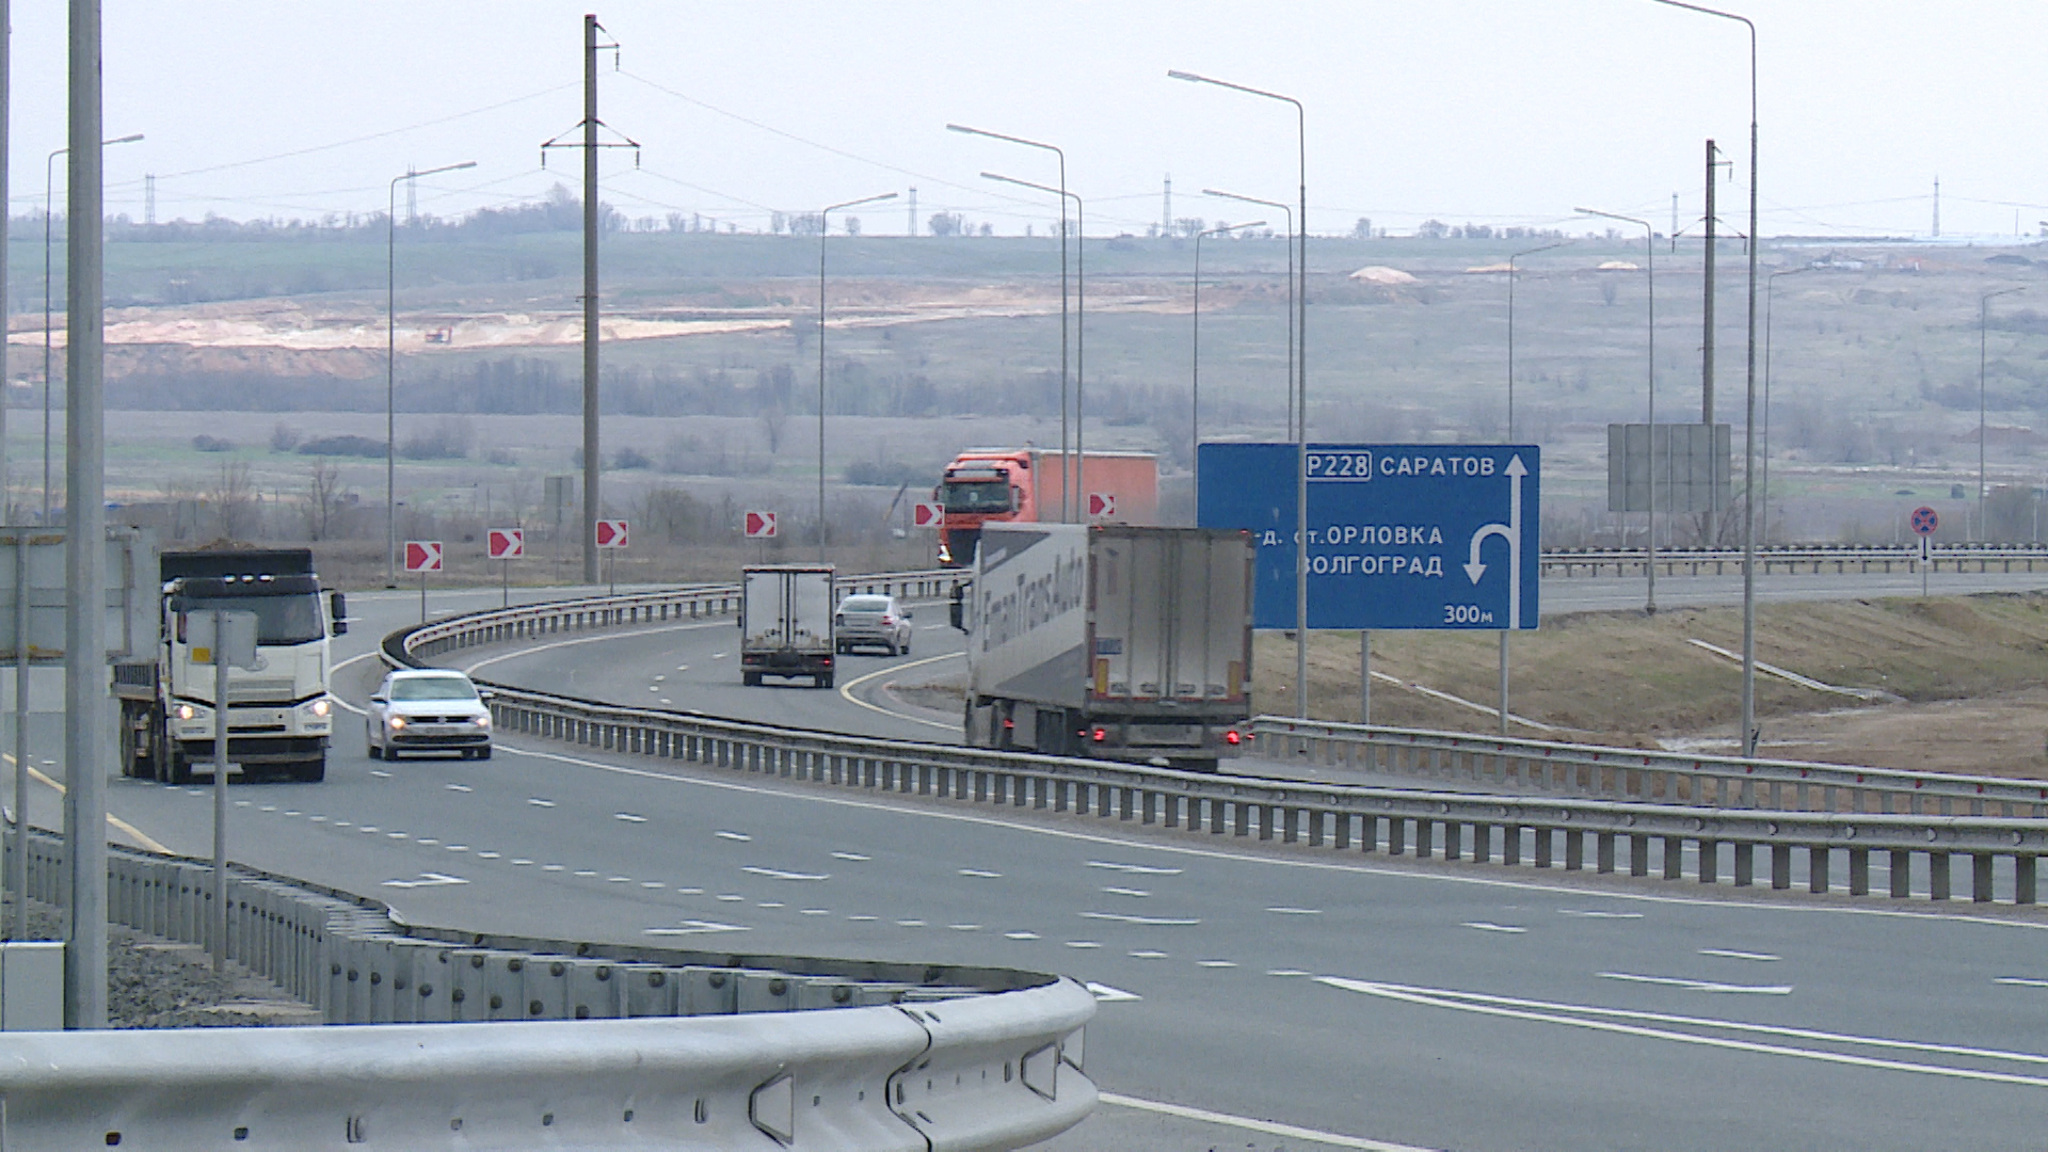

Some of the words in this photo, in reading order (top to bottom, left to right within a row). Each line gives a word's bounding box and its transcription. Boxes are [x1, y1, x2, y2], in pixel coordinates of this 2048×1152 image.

[1307, 455, 1368, 477] Р228
[1380, 457, 1496, 476] САРАТОВ
[1443, 604, 1493, 623] 300м
